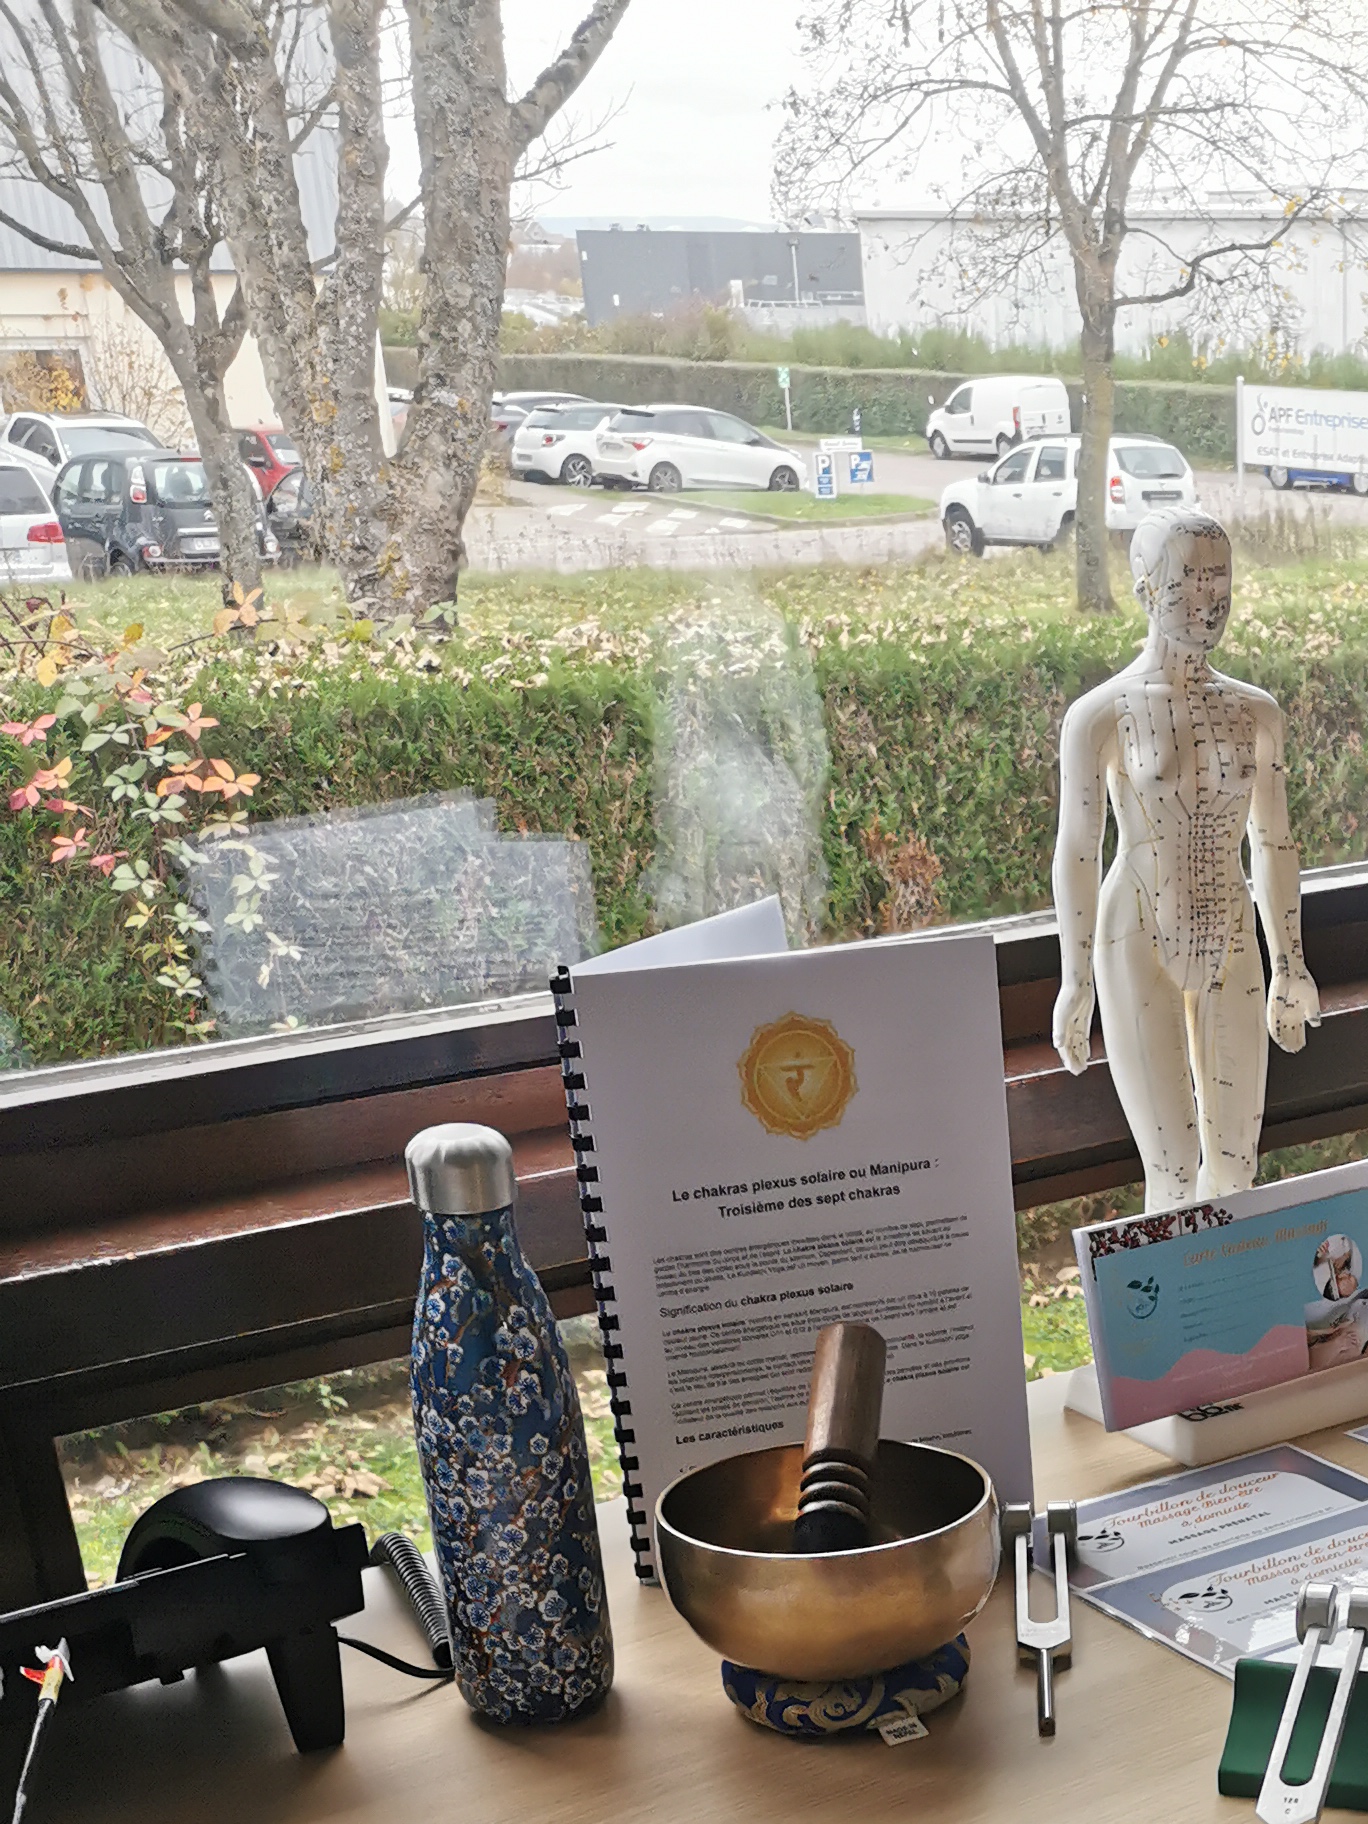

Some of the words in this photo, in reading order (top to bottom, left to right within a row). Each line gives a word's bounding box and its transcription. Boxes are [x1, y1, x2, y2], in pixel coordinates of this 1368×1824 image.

[1268, 406, 1294, 424] APF
[672, 1190, 690, 1202] Le
[693, 1183, 748, 1199] chakras
[752, 1177, 797, 1194] plexus
[800, 1170, 846, 1186] solaire
[849, 1168, 866, 1179] ou
[870, 1160, 930, 1176] Manipura
[718, 1201, 784, 1218] Troisième
[788, 1196, 812, 1208] des
[816, 1191, 845, 1206] sept
[848, 1185, 900, 1201] chakras
[659, 1302, 722, 1318] Signification
[724, 1299, 738, 1308] du
[740, 1294, 777, 1306] chakra
[779, 1288, 815, 1302] plexus
[818, 1282, 854, 1295] solaire
[676, 1435, 696, 1445] Les
[698, 1421, 784, 1441] caractéristiques
[1112, 1499, 1189, 1528] Tourbillon
[1198, 1490, 1212, 1502] de
[1223, 1468, 1276, 1494] douceur
[1141, 1506, 1197, 1526] Massage
[1205, 1486, 1260, 1508] Bien-être
[1196, 1502, 1250, 1524] domicile
[1168, 1528, 1218, 1545] MASSAGE
[1212, 1556, 1292, 1586] Tourbillon
[1305, 1546, 1318, 1557] de
[1248, 1563, 1305, 1584] Massage
[1306, 1558, 1361, 1580] domicile
[1264, 1591, 1299, 1604] MASSA
